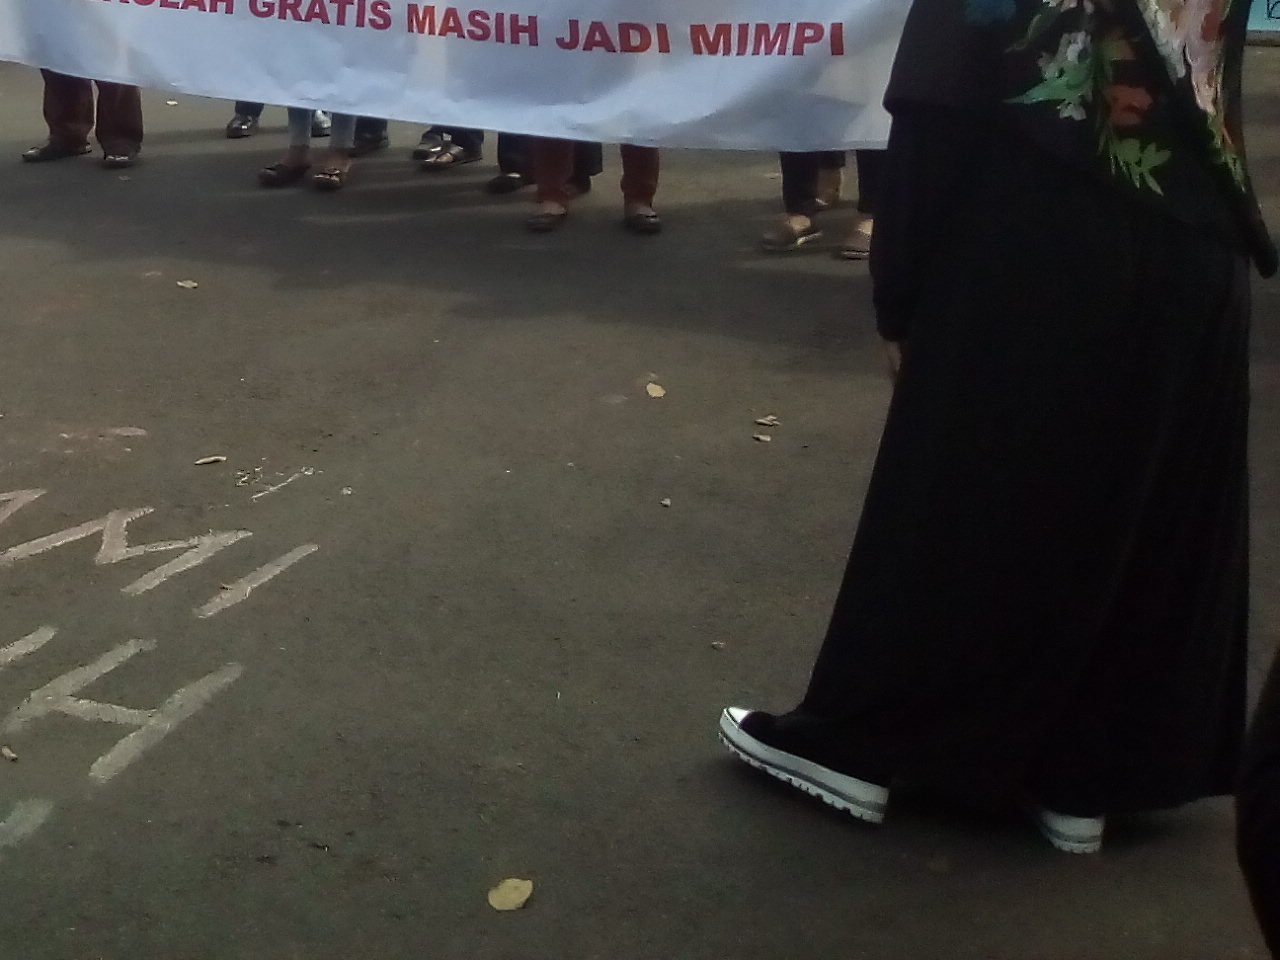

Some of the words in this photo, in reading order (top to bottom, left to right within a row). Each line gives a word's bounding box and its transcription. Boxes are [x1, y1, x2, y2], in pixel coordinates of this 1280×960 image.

[406, 3, 539, 46] MASIH
[556, 18, 671, 53] JADI
[689, 21, 844, 57] MIMPI
